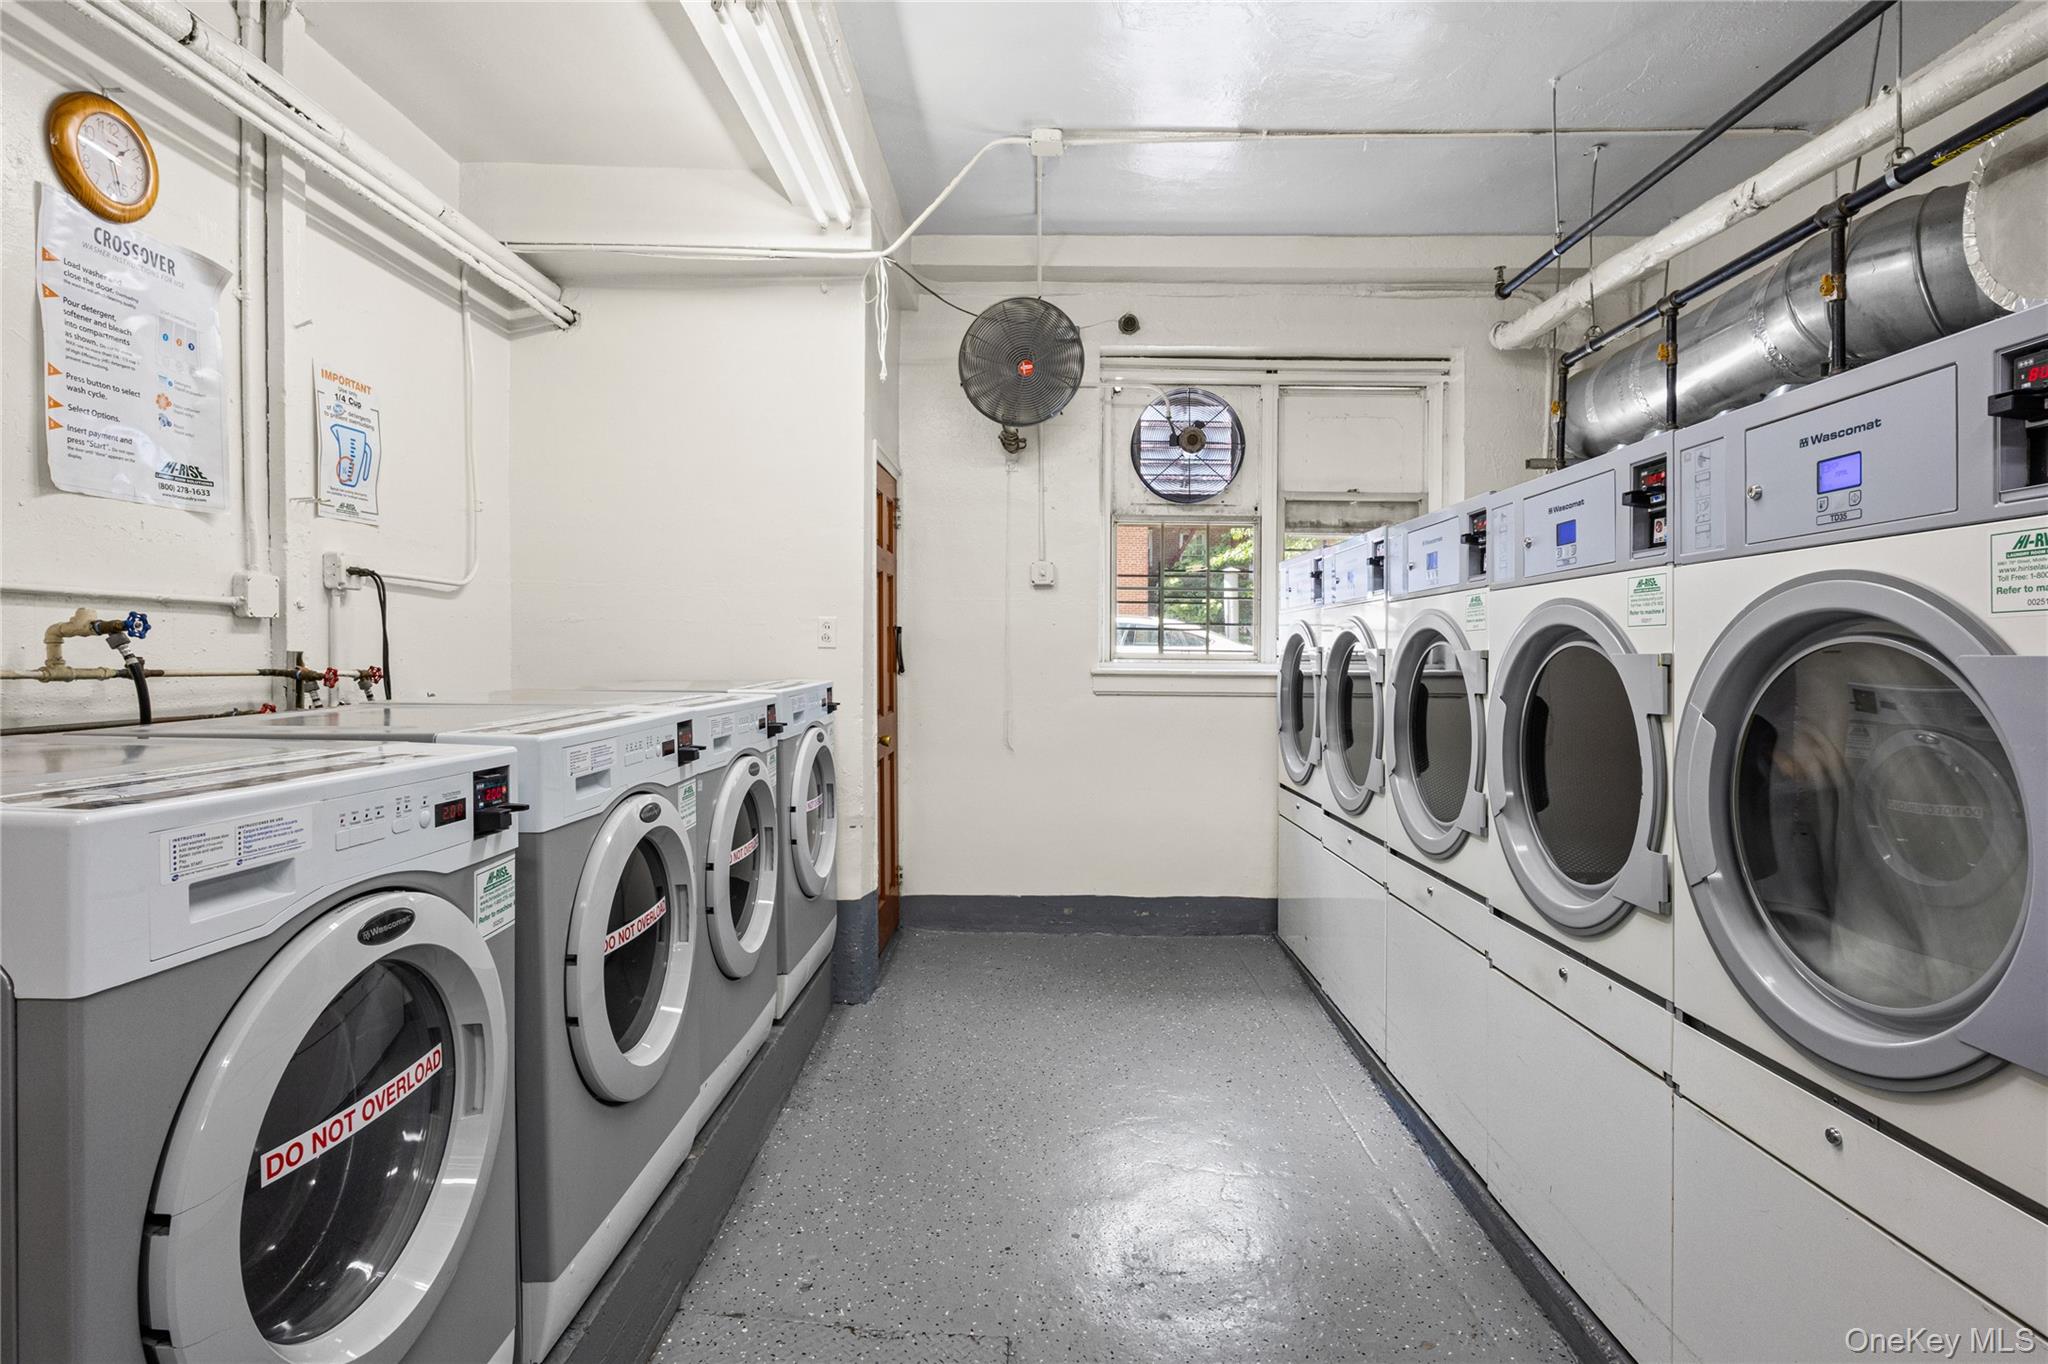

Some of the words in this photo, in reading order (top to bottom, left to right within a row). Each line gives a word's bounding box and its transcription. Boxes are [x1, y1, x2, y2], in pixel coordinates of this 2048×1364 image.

[108, 122, 119, 139] 12
[82, 240, 111, 259] WASHER
[94, 227, 175, 276] CROSSOVER
[64, 258, 81, 272] Load
[82, 266, 107, 280] washer
[64, 270, 81, 282] close
[83, 276, 94, 287] the
[96, 281, 114, 294] door.
[63, 296, 80, 309] Pour
[81, 303, 117, 322] detergent,
[63, 308, 92, 325] softener
[94, 318, 107, 329] and
[108, 321, 132, 337] bleach
[64, 320, 77, 330] into
[79, 324, 131, 347] compartments
[74, 332, 99, 346] shown.
[66, 372, 85, 384] Press
[86, 379, 112, 393] button
[112, 384, 120, 392] to
[121, 386, 141, 398] select
[66, 383, 87, 397] wash
[88, 389, 108, 401] cycle.
[321, 369, 372, 395] IMPORTANT
[334, 393, 346, 403] 1/4
[348, 397, 362, 409] Cup
[68, 403, 90, 416] Select
[91, 409, 121, 423] Options.
[67, 424, 87, 436] Insert
[89, 430, 119, 443] payment
[120, 435, 133, 445] and
[67, 437, 85, 448] press
[1810, 418, 1882, 446] Wascomat
[160, 462, 208, 480] HI-RISE
[158, 482, 176, 493] (800)
[177, 486, 211, 497] 278-1633
[1553, 499, 1585, 513] Wascomat
[1997, 585, 2022, 595] Refer
[2024, 585, 2034, 593] to
[172, 833, 206, 843] INSTRUCTIONS
[370, 914, 411, 936] Wascomat
[619, 923, 635, 945] NOT
[266, 1142, 304, 1180] DO
[312, 1110, 356, 1154] NOT
[362, 1050, 441, 1121] OVERLOAD
